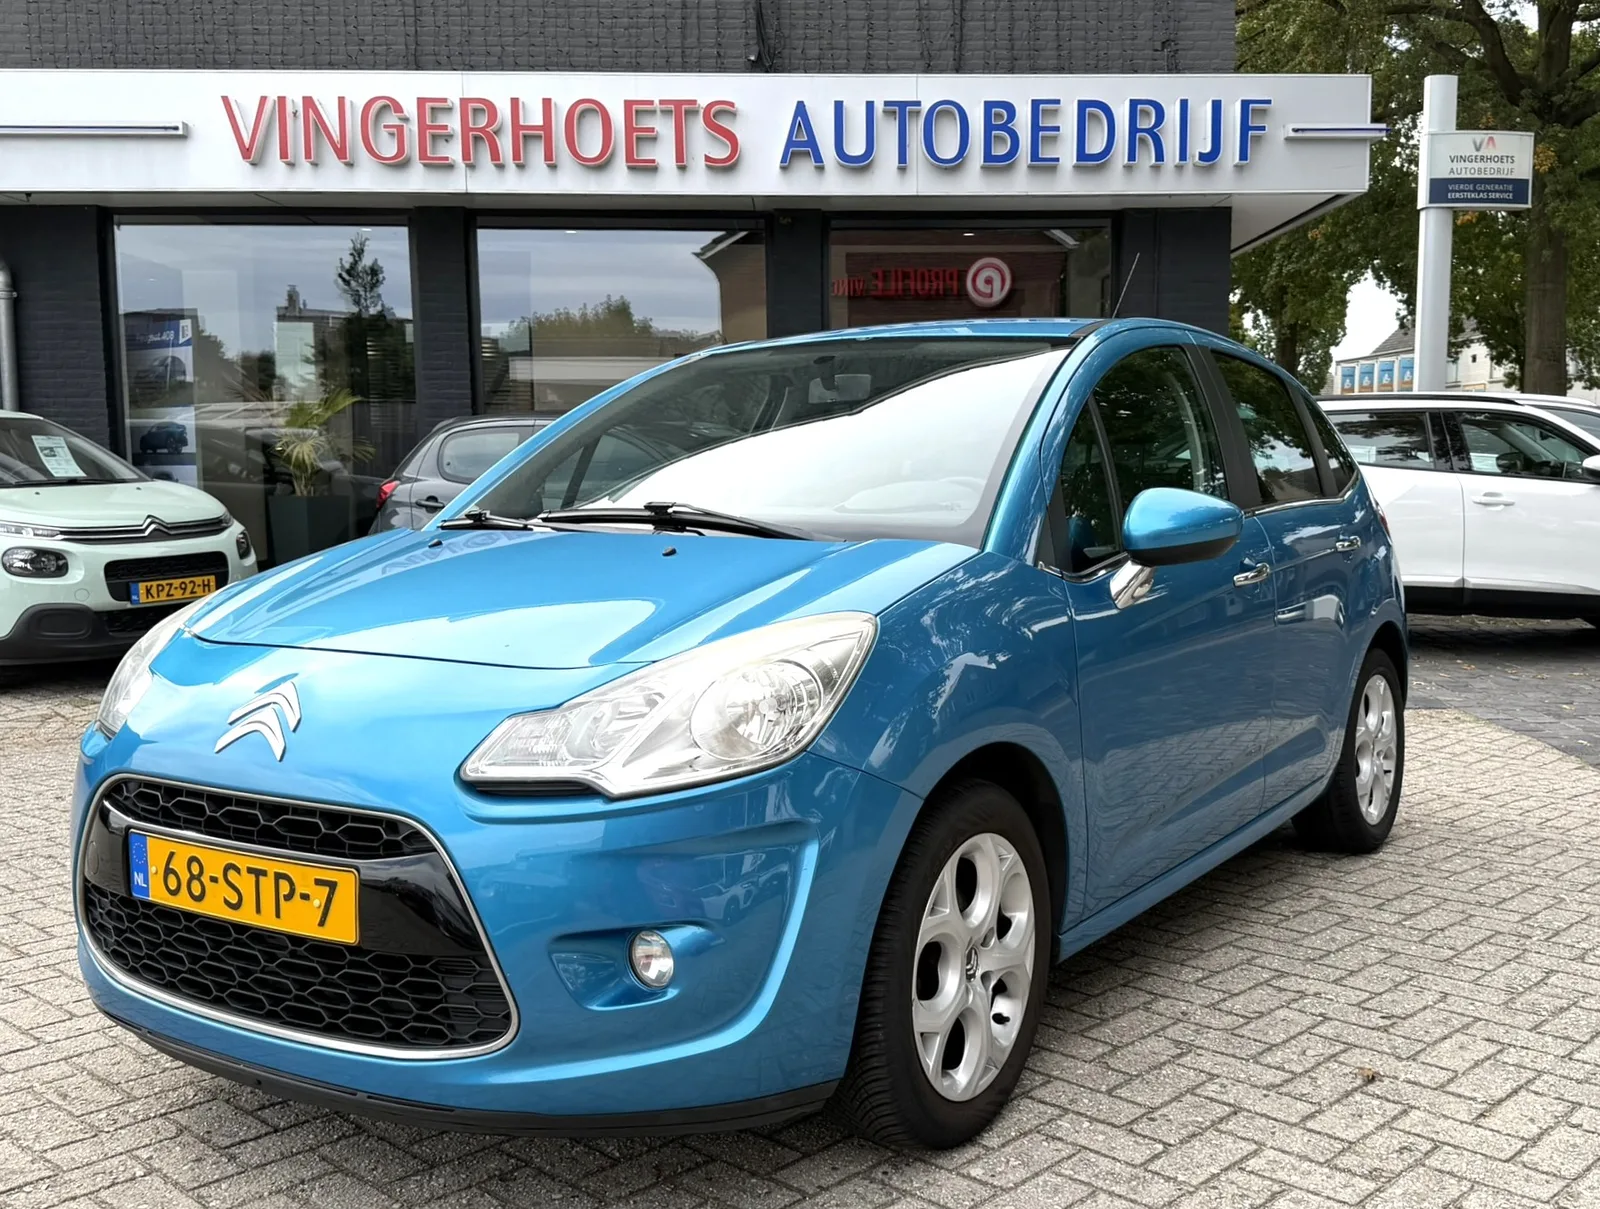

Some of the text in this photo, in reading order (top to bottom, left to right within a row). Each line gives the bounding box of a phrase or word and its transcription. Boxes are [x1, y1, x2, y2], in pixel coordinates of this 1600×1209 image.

[220, 95, 1273, 168] VINGERHOETS AUTOBEDRIJF
[1449, 154, 1516, 164] VINGERHOETS
[1448, 167, 1515, 176] AUTOBEDRIJF
[145, 578, 211, 600] KPZ-92-H
[133, 871, 147, 888] NL
[162, 850, 339, 928] 68-STP-7
